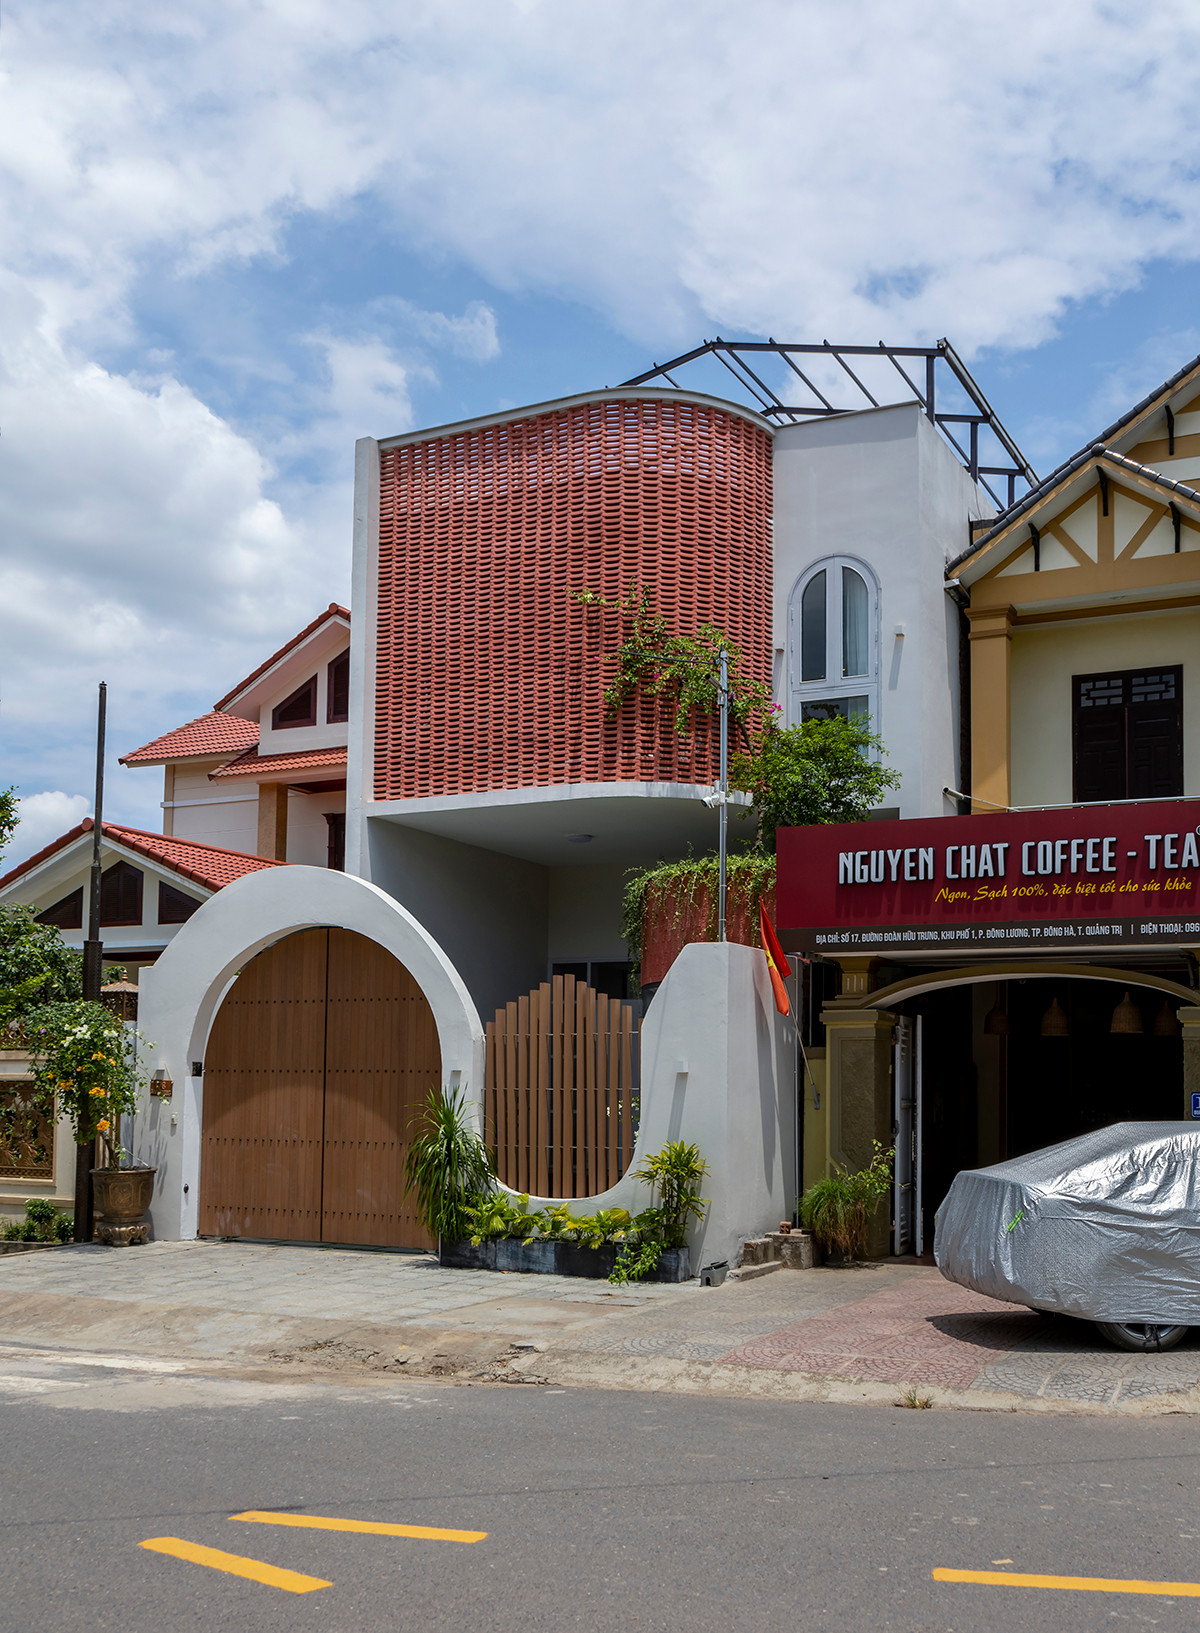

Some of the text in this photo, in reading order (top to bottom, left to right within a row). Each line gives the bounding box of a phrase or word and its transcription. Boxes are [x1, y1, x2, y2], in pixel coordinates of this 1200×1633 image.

[838, 846, 935, 884] NGUYEN
[945, 842, 1010, 879] CHAT
[1021, 836, 1118, 876] COFFEE
[1144, 832, 1200, 870] TEA
[934, 887, 971, 903] Ngon,
[973, 884, 1008, 901] Sạch
[1011, 883, 1049, 897] 100%,
[1075, 881, 1097, 897] biệt
[1099, 879, 1116, 893] tốt
[1119, 879, 1139, 893] cho
[1141, 879, 1161, 892] sức
[1164, 876, 1192, 891] khỏe
[841, 931, 850, 943] SỐ
[941, 930, 955, 940] KHU
[956, 927, 970, 940] PHỐ
[978, 929, 985, 939] P.
[1031, 927, 1043, 938] TP.
[1077, 926, 1084, 936] T.
[1085, 923, 1110, 936] QUẢNG
[1111, 925, 1123, 937] TRỊ
